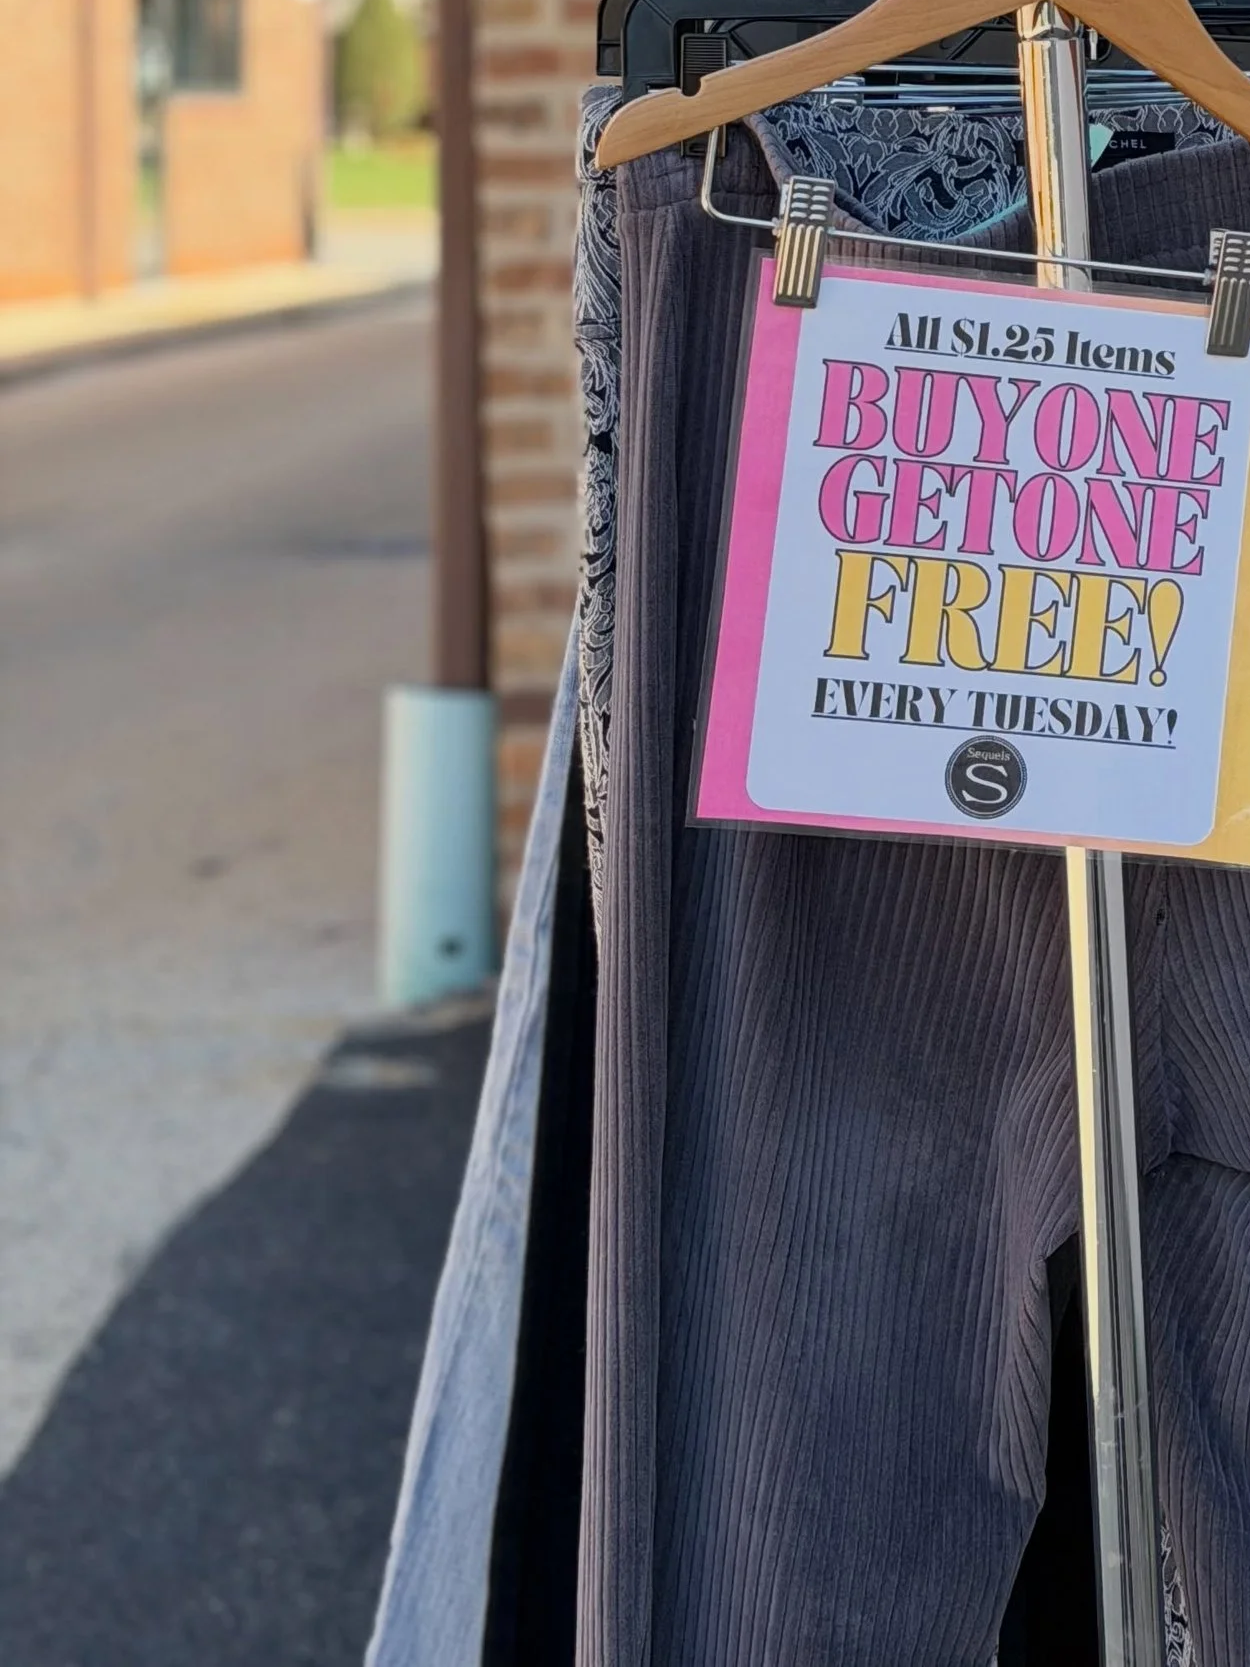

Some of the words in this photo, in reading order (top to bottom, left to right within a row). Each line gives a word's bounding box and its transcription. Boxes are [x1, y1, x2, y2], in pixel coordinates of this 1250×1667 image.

[886, 312, 942, 351] All
[951, 316, 1055, 363] $1.25
[1065, 330, 1176, 376] Items
[823, 548, 1184, 687] FREE!
[813, 677, 958, 725] EVERY
[967, 690, 1179, 745] TUESDAY!
[961, 762, 1009, 804] S
[967, 746, 1011, 762] Sequels
